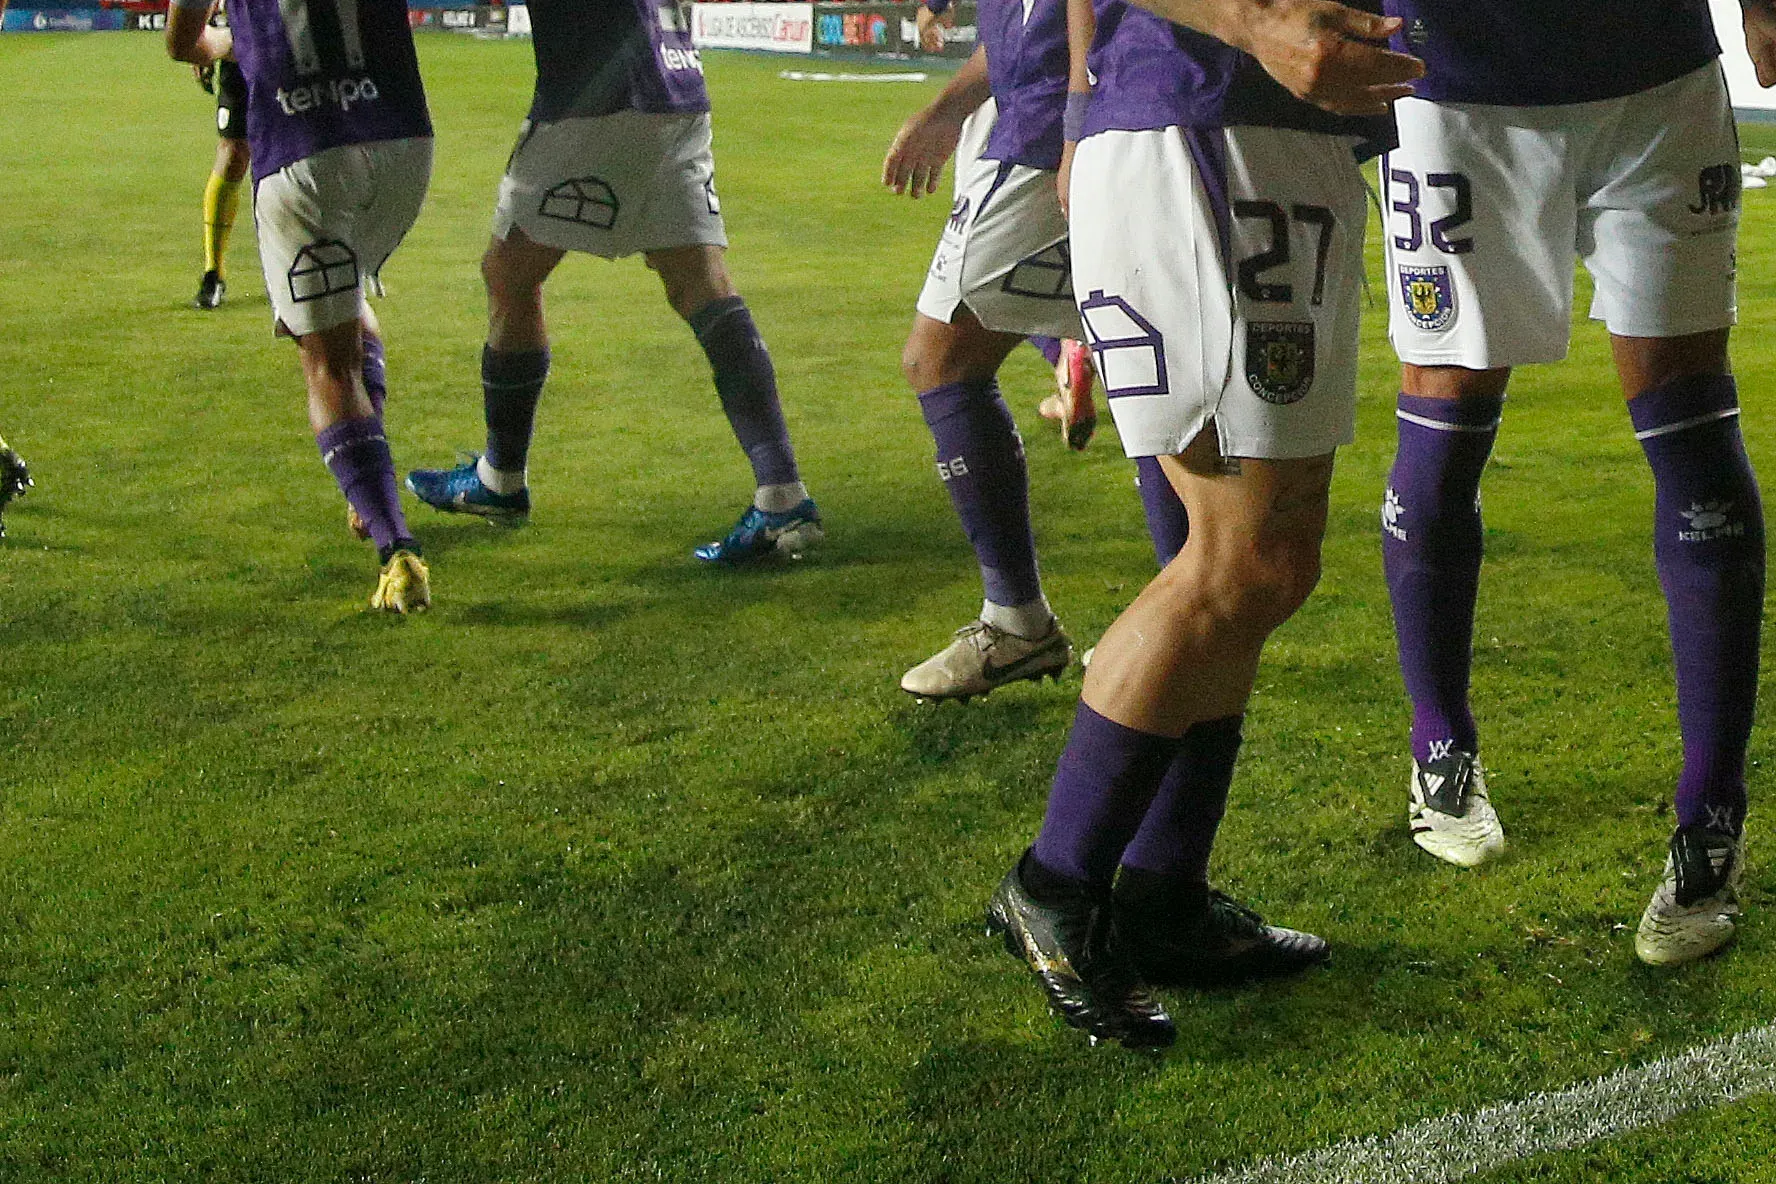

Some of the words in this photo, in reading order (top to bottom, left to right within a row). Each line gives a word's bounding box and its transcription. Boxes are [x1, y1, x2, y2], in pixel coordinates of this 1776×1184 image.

[275, 77, 379, 115] tempo
[1391, 169, 1475, 255] 32
[1233, 198, 1336, 306] 27
[1399, 265, 1446, 276] DEPORTES
[1251, 321, 1312, 334] DEPORTES
